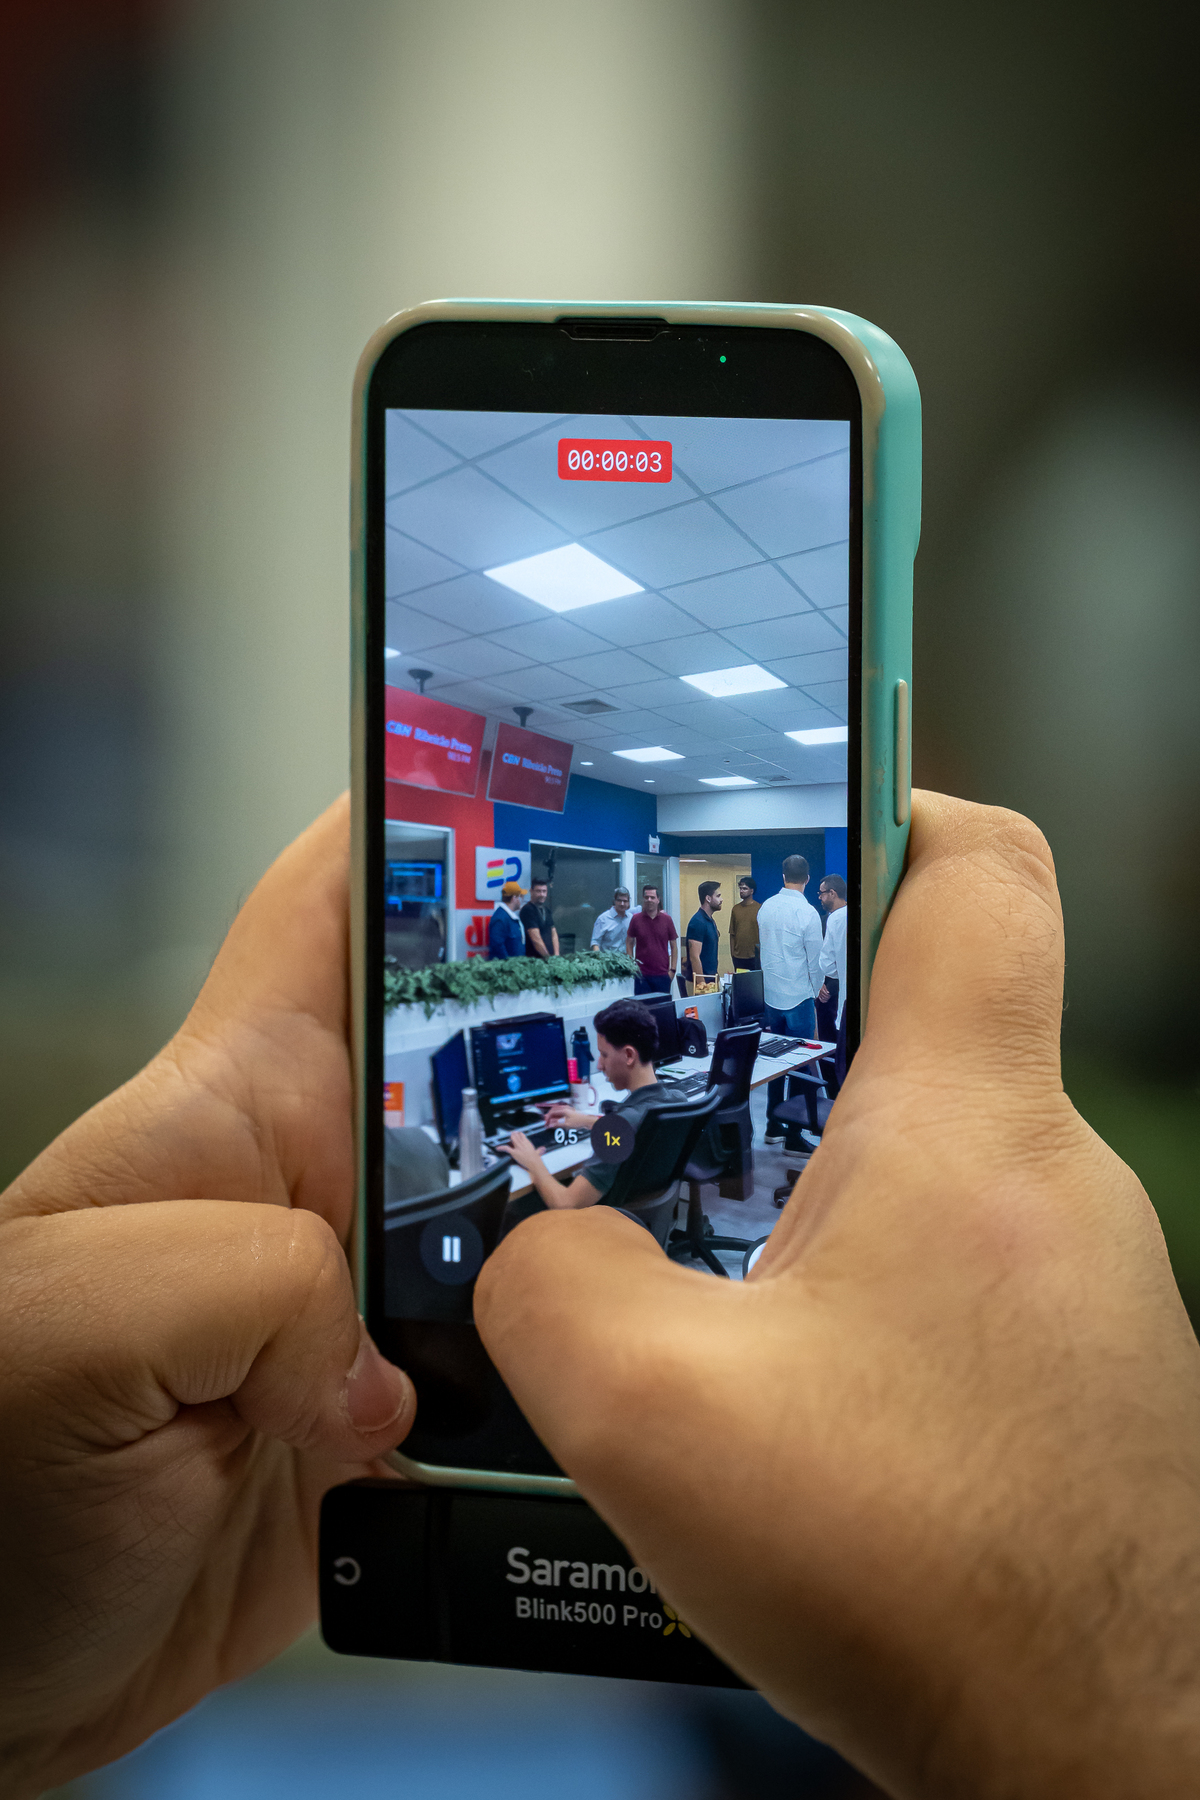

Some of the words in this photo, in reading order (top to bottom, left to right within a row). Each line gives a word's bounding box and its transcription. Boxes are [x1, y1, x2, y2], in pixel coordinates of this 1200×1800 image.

[568, 449, 662, 473] 00:00:03
[386, 719, 412, 737] CBN
[502, 752, 521, 766] CBN
[604, 1131, 621, 1146] 1x
[505, 1546, 658, 1595] Saramo
[515, 1596, 616, 1625] Blink500
[623, 1605, 663, 1629] Pro
